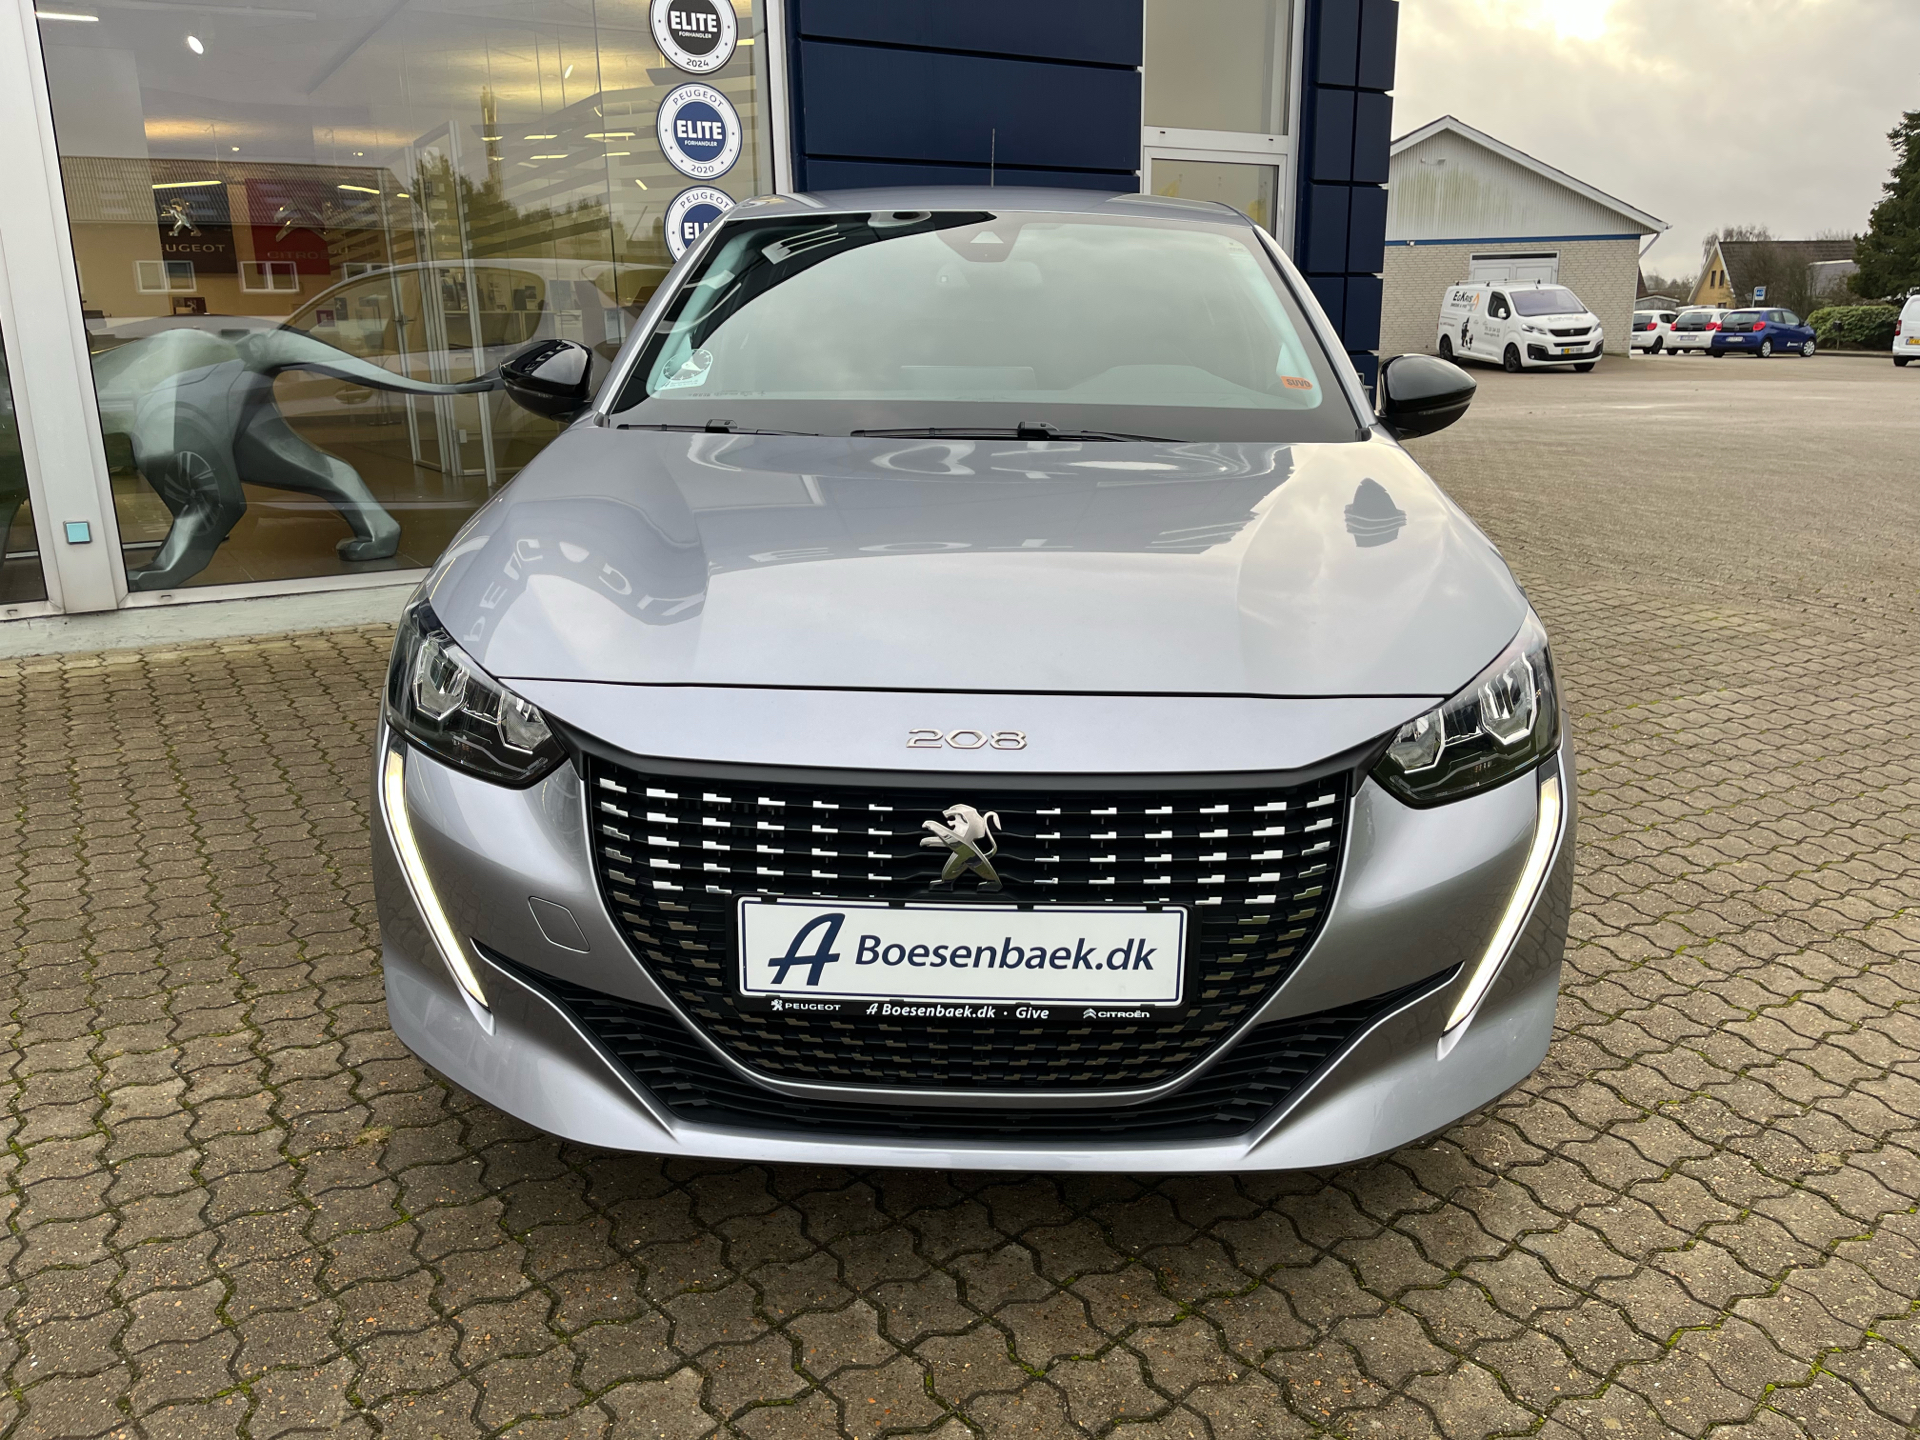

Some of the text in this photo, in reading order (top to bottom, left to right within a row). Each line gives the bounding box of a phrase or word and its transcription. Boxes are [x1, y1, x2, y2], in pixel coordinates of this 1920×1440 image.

[670, 10, 718, 33] ELITE
[678, 31, 712, 39] FORHANDLER
[686, 57, 710, 68] 2024
[672, 89, 725, 108] PEUGEOT
[676, 119, 723, 140] ELITE
[690, 164, 714, 174] 2020
[679, 192, 731, 209] PEUGEOT
[906, 728, 1028, 750] 208
[768, 912, 1157, 986] A Boesenbaek.dk
[784, 1003, 842, 1011] PEUGEOT
[882, 1003, 996, 1018] Boesenbaek.dk
[1015, 1006, 1050, 1019] Give
